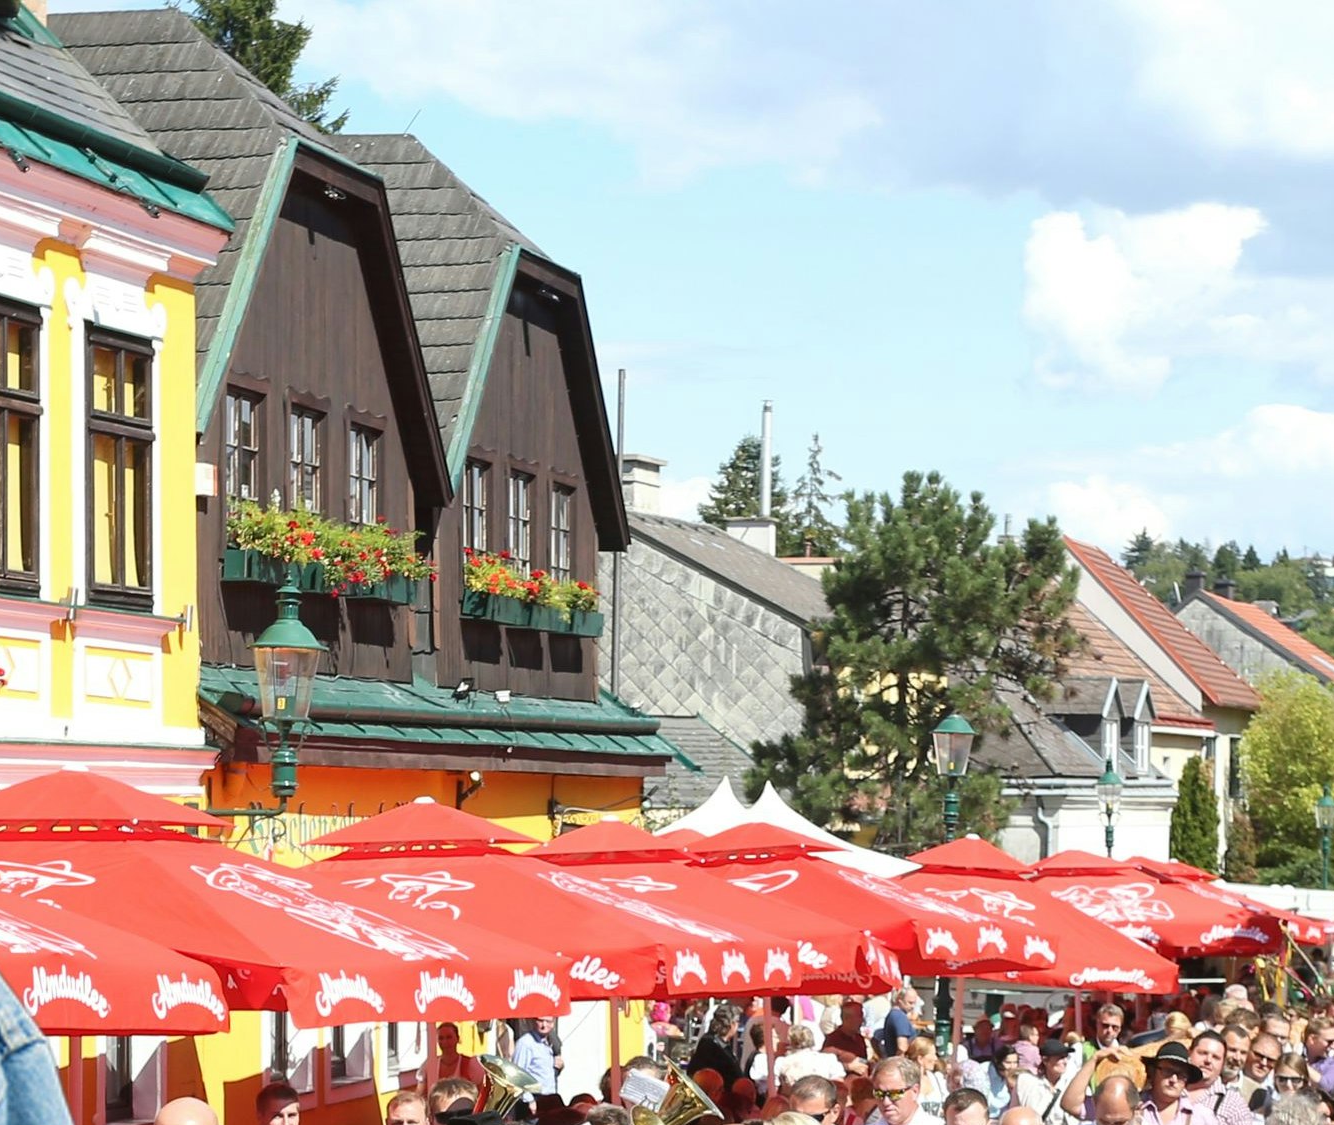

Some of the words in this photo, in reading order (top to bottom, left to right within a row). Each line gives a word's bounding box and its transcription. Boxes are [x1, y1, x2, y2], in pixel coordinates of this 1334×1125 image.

[24, 964, 110, 1019] Almdudler
[315, 969, 385, 1017] Almdudler
[415, 967, 475, 1014] Almdudler
